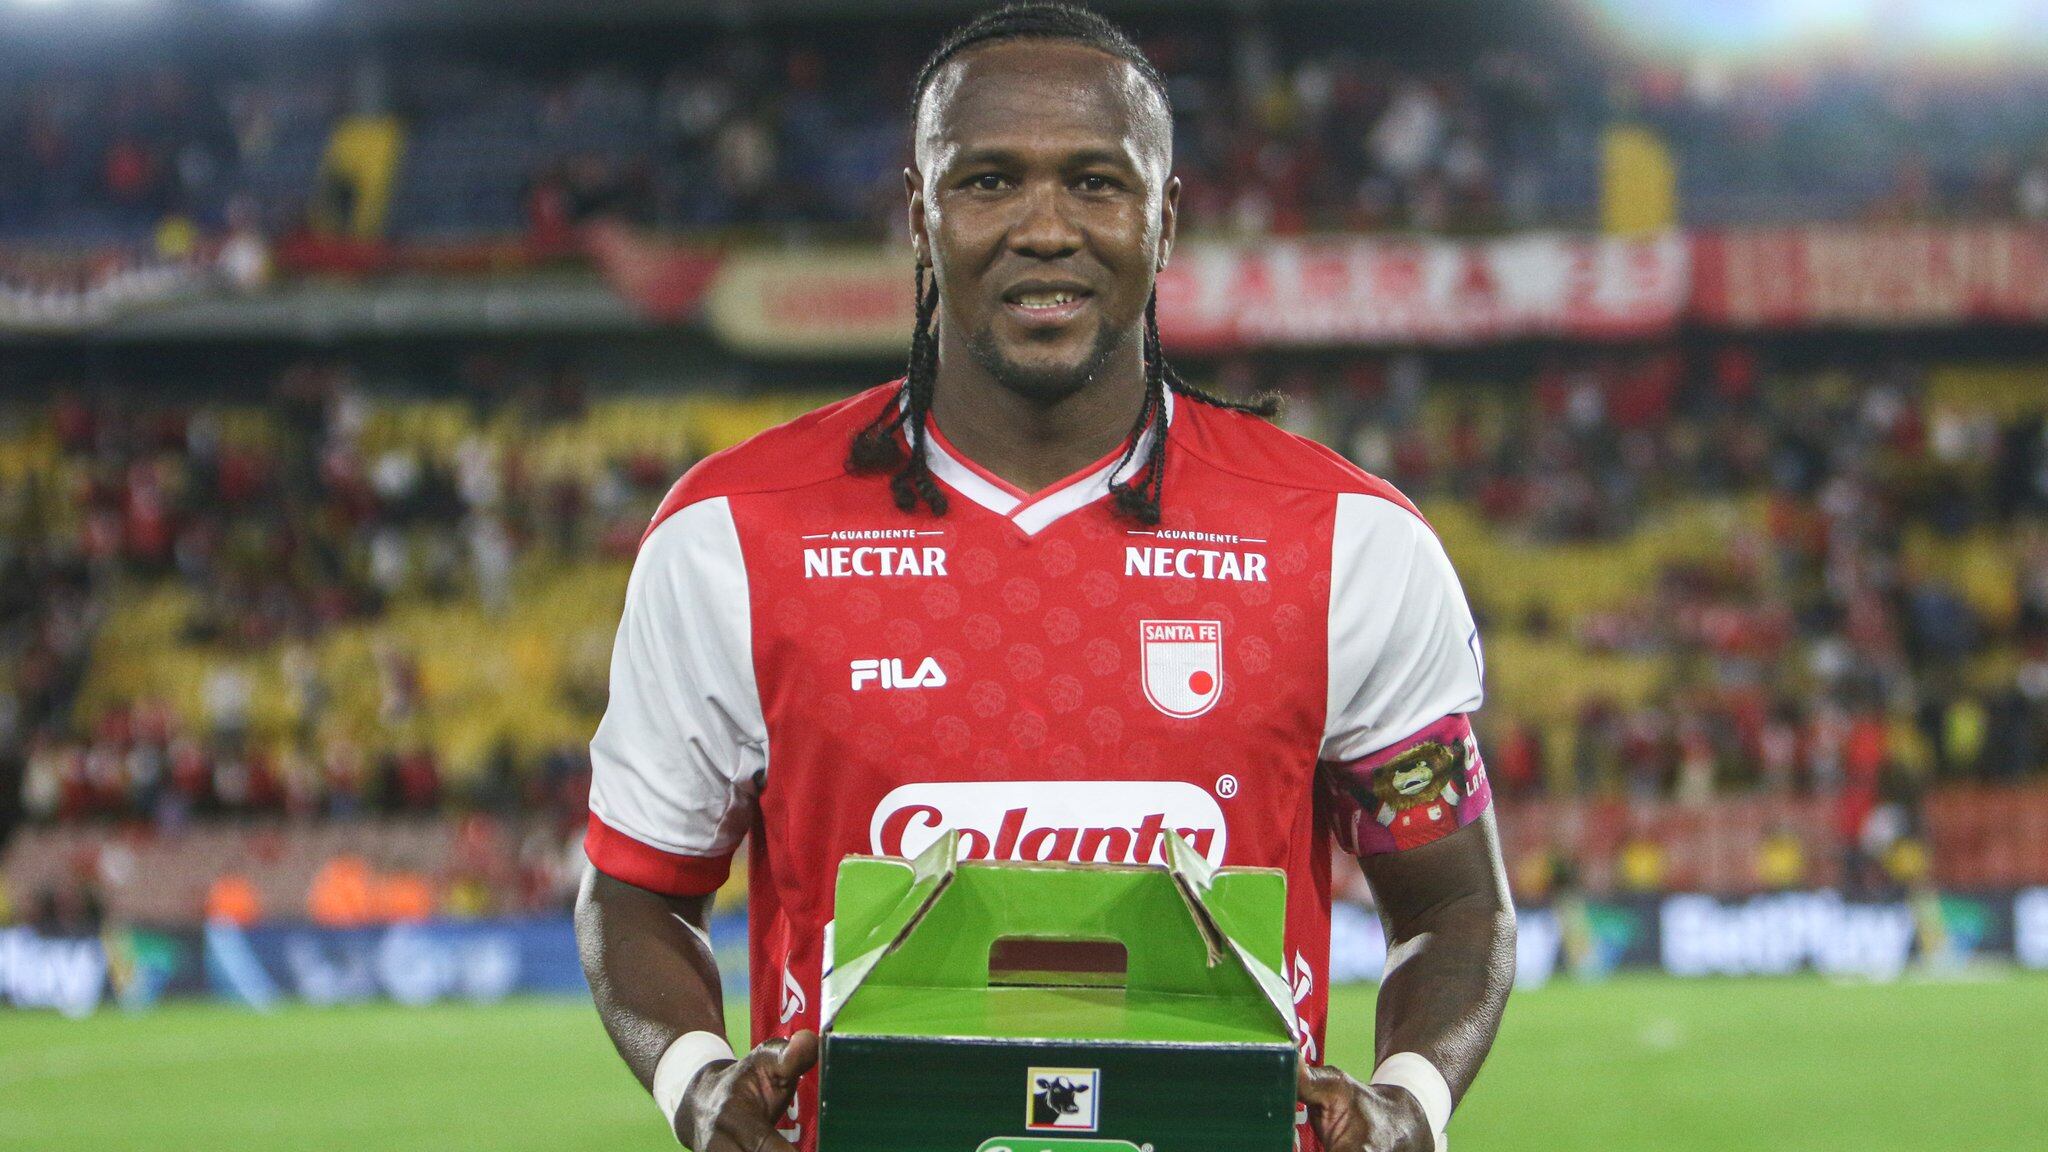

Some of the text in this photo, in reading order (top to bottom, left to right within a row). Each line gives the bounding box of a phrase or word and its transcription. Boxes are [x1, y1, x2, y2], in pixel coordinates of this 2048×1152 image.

[831, 529, 916, 540] AGUARDIENTE
[1156, 530, 1239, 544] AGUARDIENTE
[803, 546, 948, 579] NECTAR
[1124, 546, 1267, 582] NECTAR
[1146, 625, 1217, 641] SANTA FE
[850, 656, 948, 692] FILA
